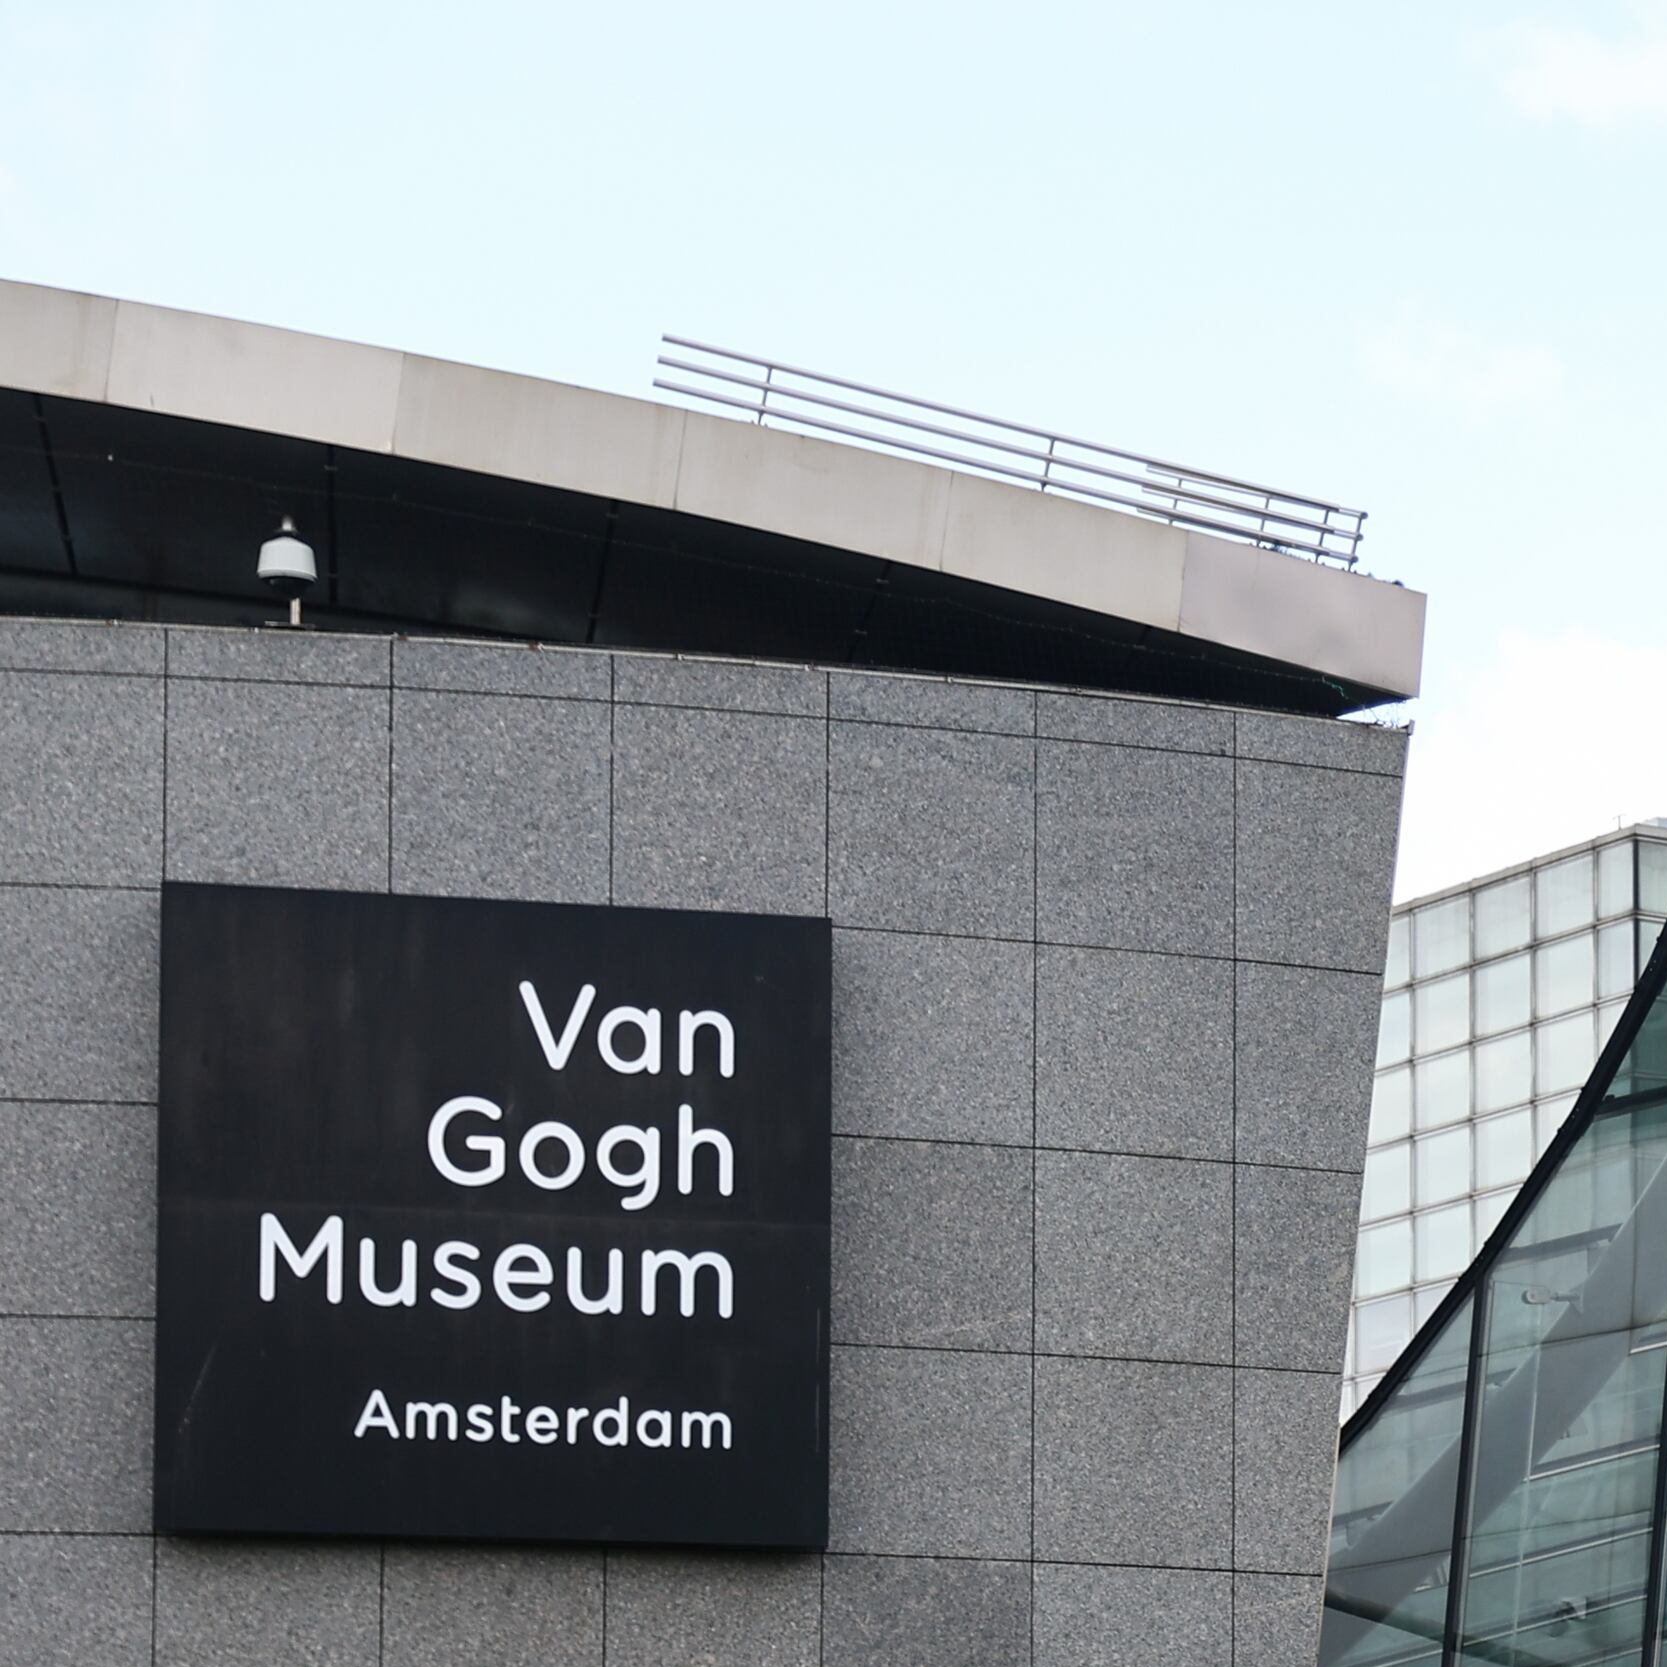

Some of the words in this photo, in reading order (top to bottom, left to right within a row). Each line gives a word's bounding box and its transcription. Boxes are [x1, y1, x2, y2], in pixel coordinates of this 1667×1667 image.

[518, 980, 735, 1079] Van
[427, 1096, 735, 1211] Gogh
[258, 1212, 734, 1319] Museum
[353, 1389, 733, 1450] Amsterdam
